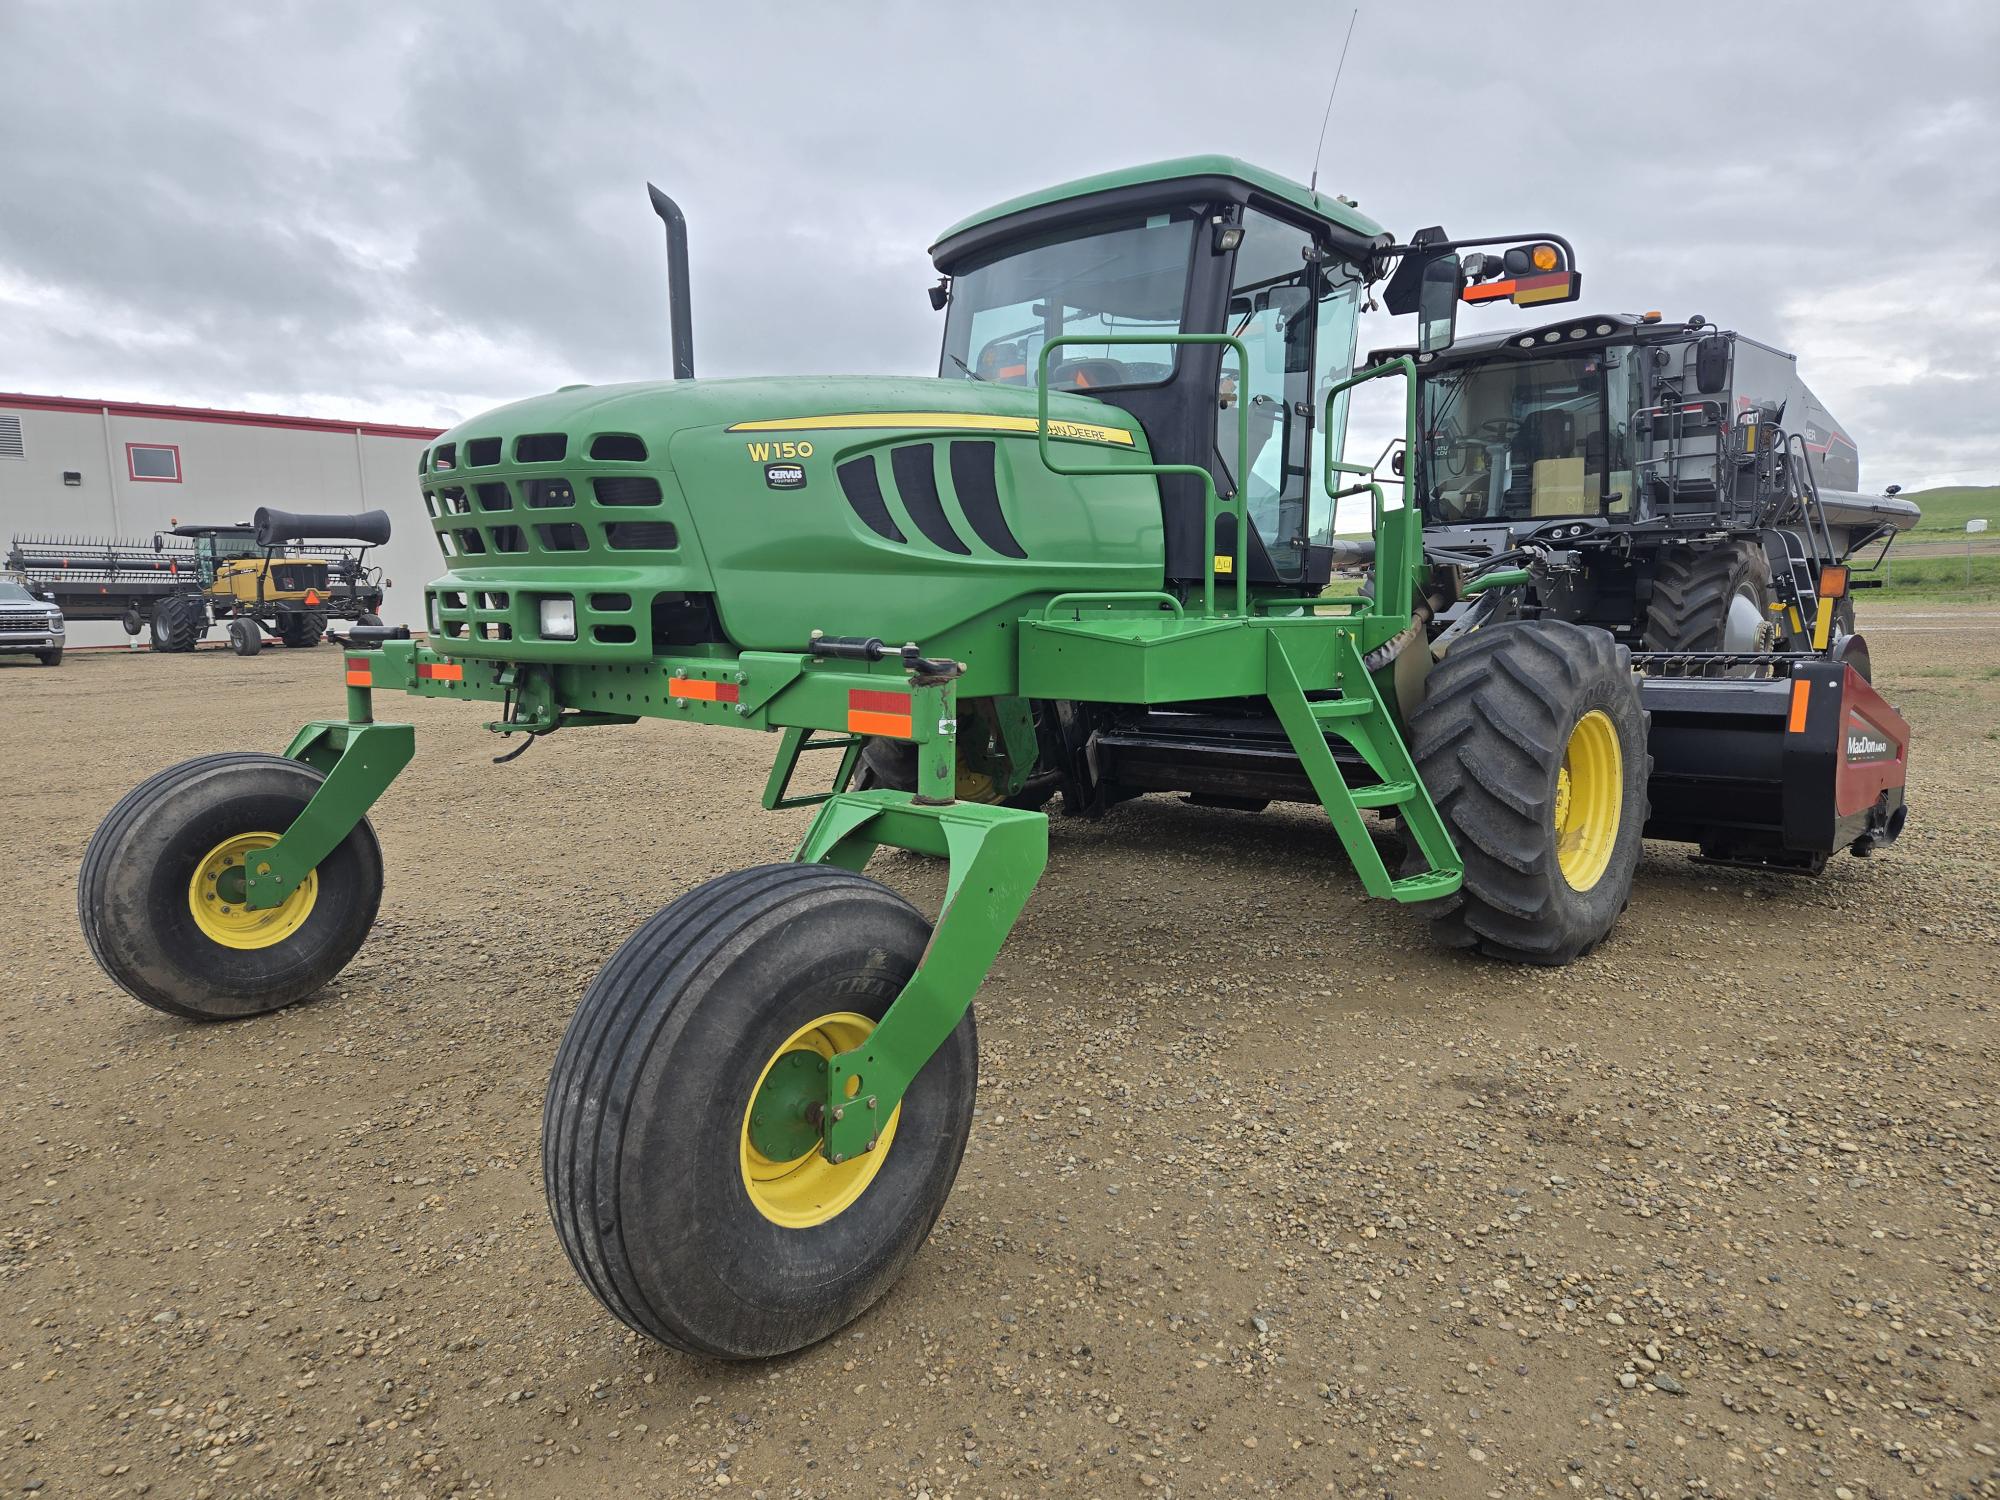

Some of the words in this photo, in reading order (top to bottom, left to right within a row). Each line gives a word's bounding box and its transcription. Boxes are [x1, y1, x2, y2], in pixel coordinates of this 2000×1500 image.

[1067, 424, 1107, 440] DEERE
[746, 440, 814, 463] W150
[768, 470, 803, 480] CERVUS
[1847, 736, 1876, 754] MacDon
